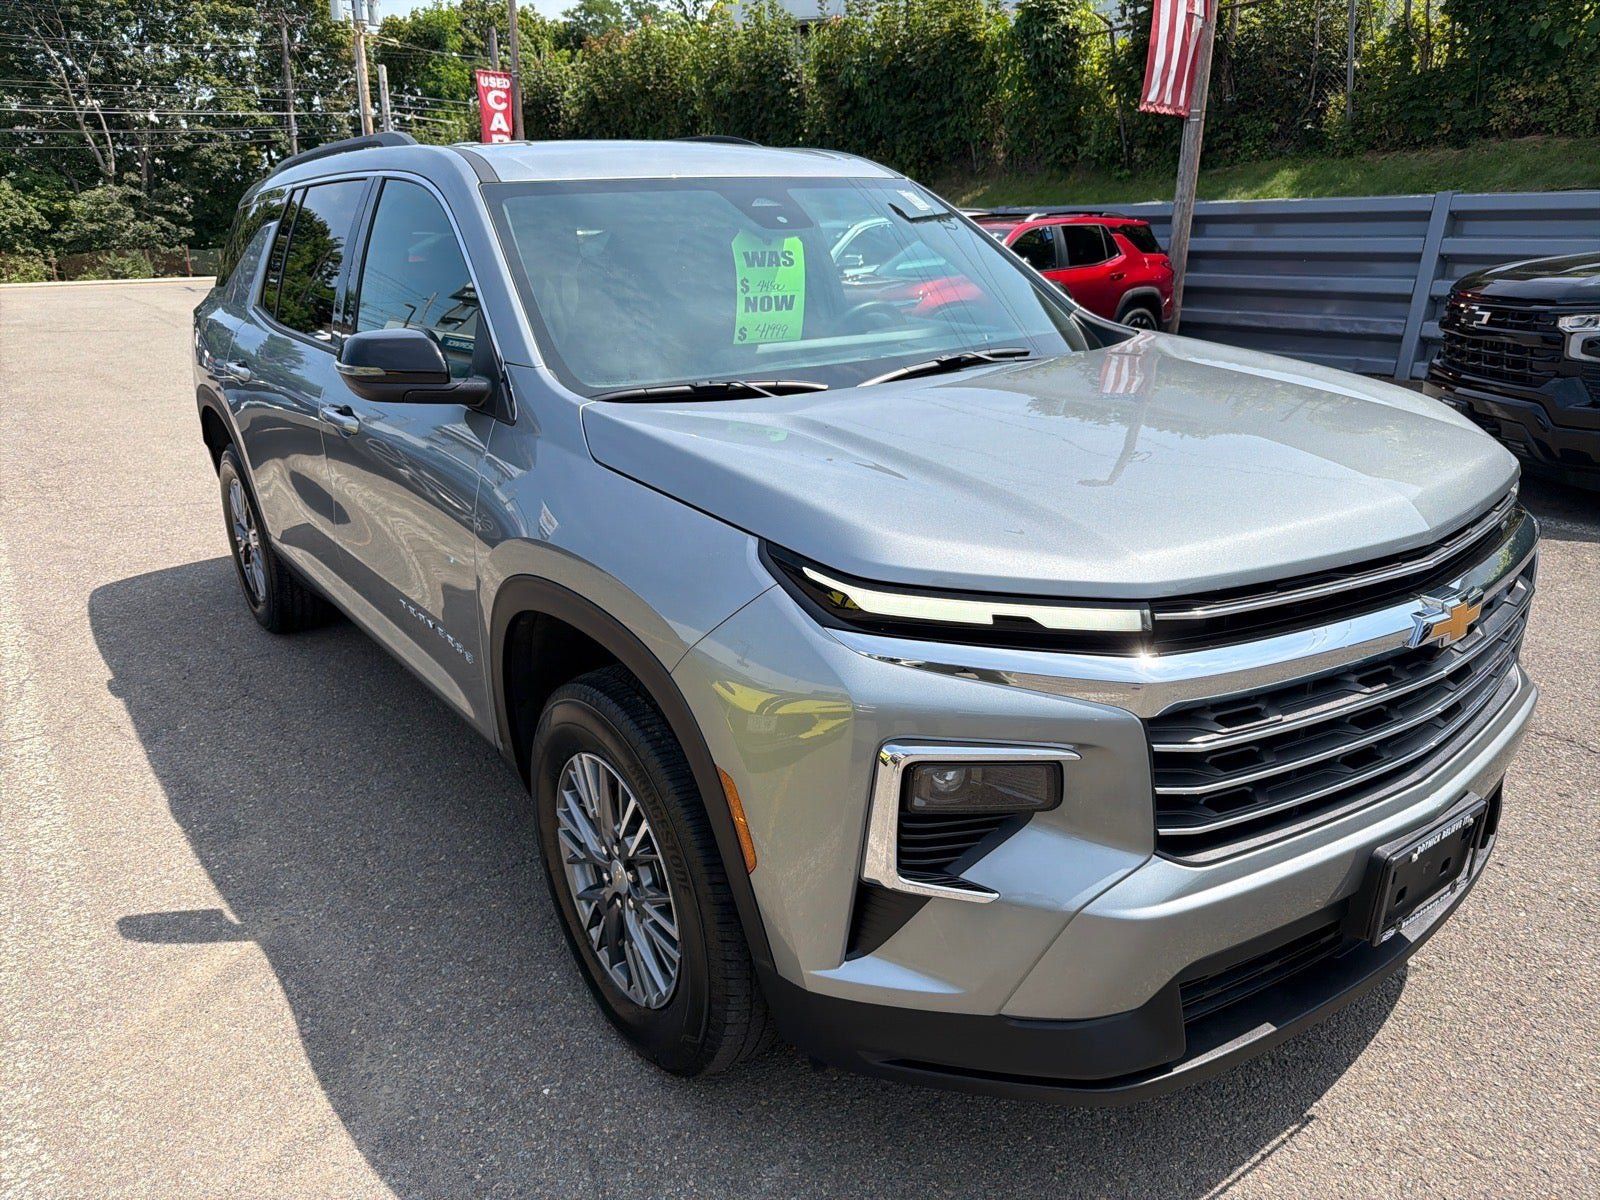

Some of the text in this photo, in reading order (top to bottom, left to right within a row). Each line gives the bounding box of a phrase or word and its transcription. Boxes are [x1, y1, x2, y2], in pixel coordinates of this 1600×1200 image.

[480, 76, 510, 89] USED
[743, 250, 795, 268] WAS
[740, 277, 750, 295] $
[744, 295, 796, 313] NOW
[738, 326, 748, 342] $
[400, 599, 474, 664] TRAVERSE
